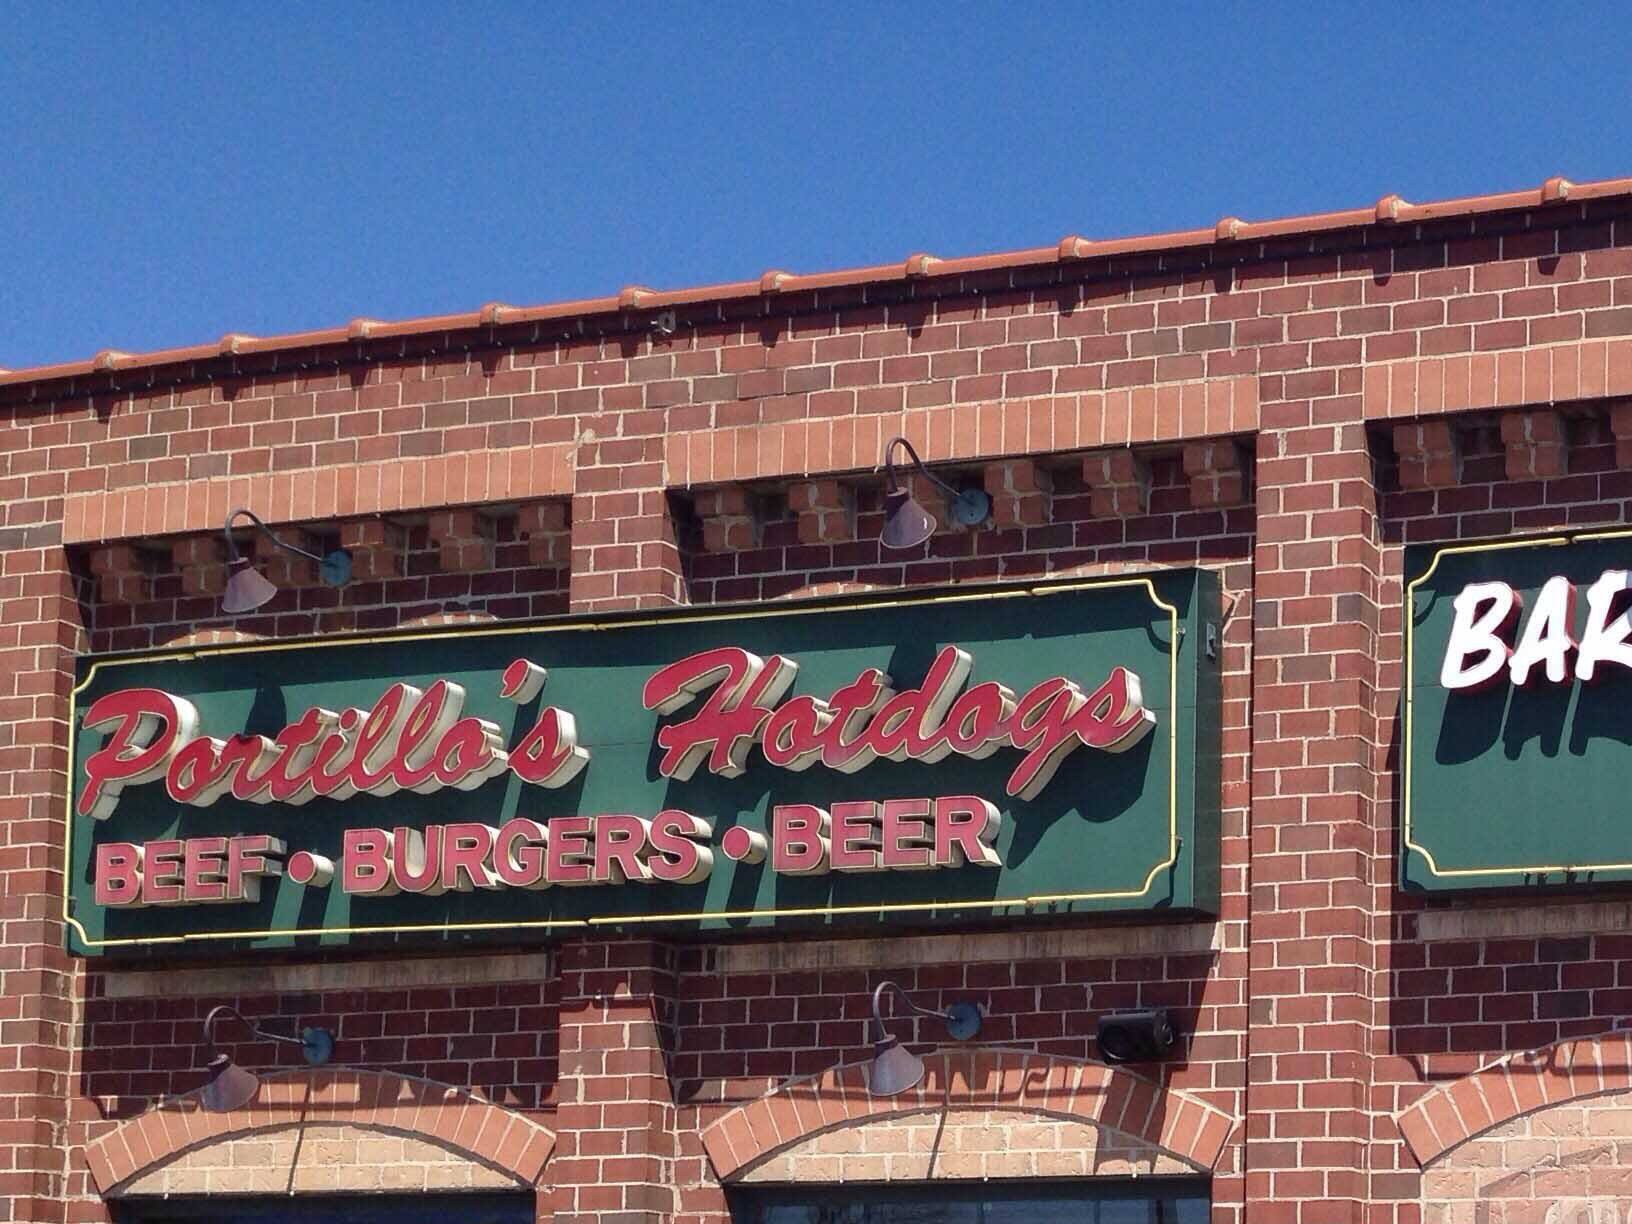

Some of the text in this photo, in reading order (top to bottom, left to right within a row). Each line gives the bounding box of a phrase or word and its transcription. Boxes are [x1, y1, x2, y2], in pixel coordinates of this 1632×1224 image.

[79, 645, 1157, 820] Portillo's Hotdogs
[95, 795, 1002, 906] BEEF BURGERS BEER
